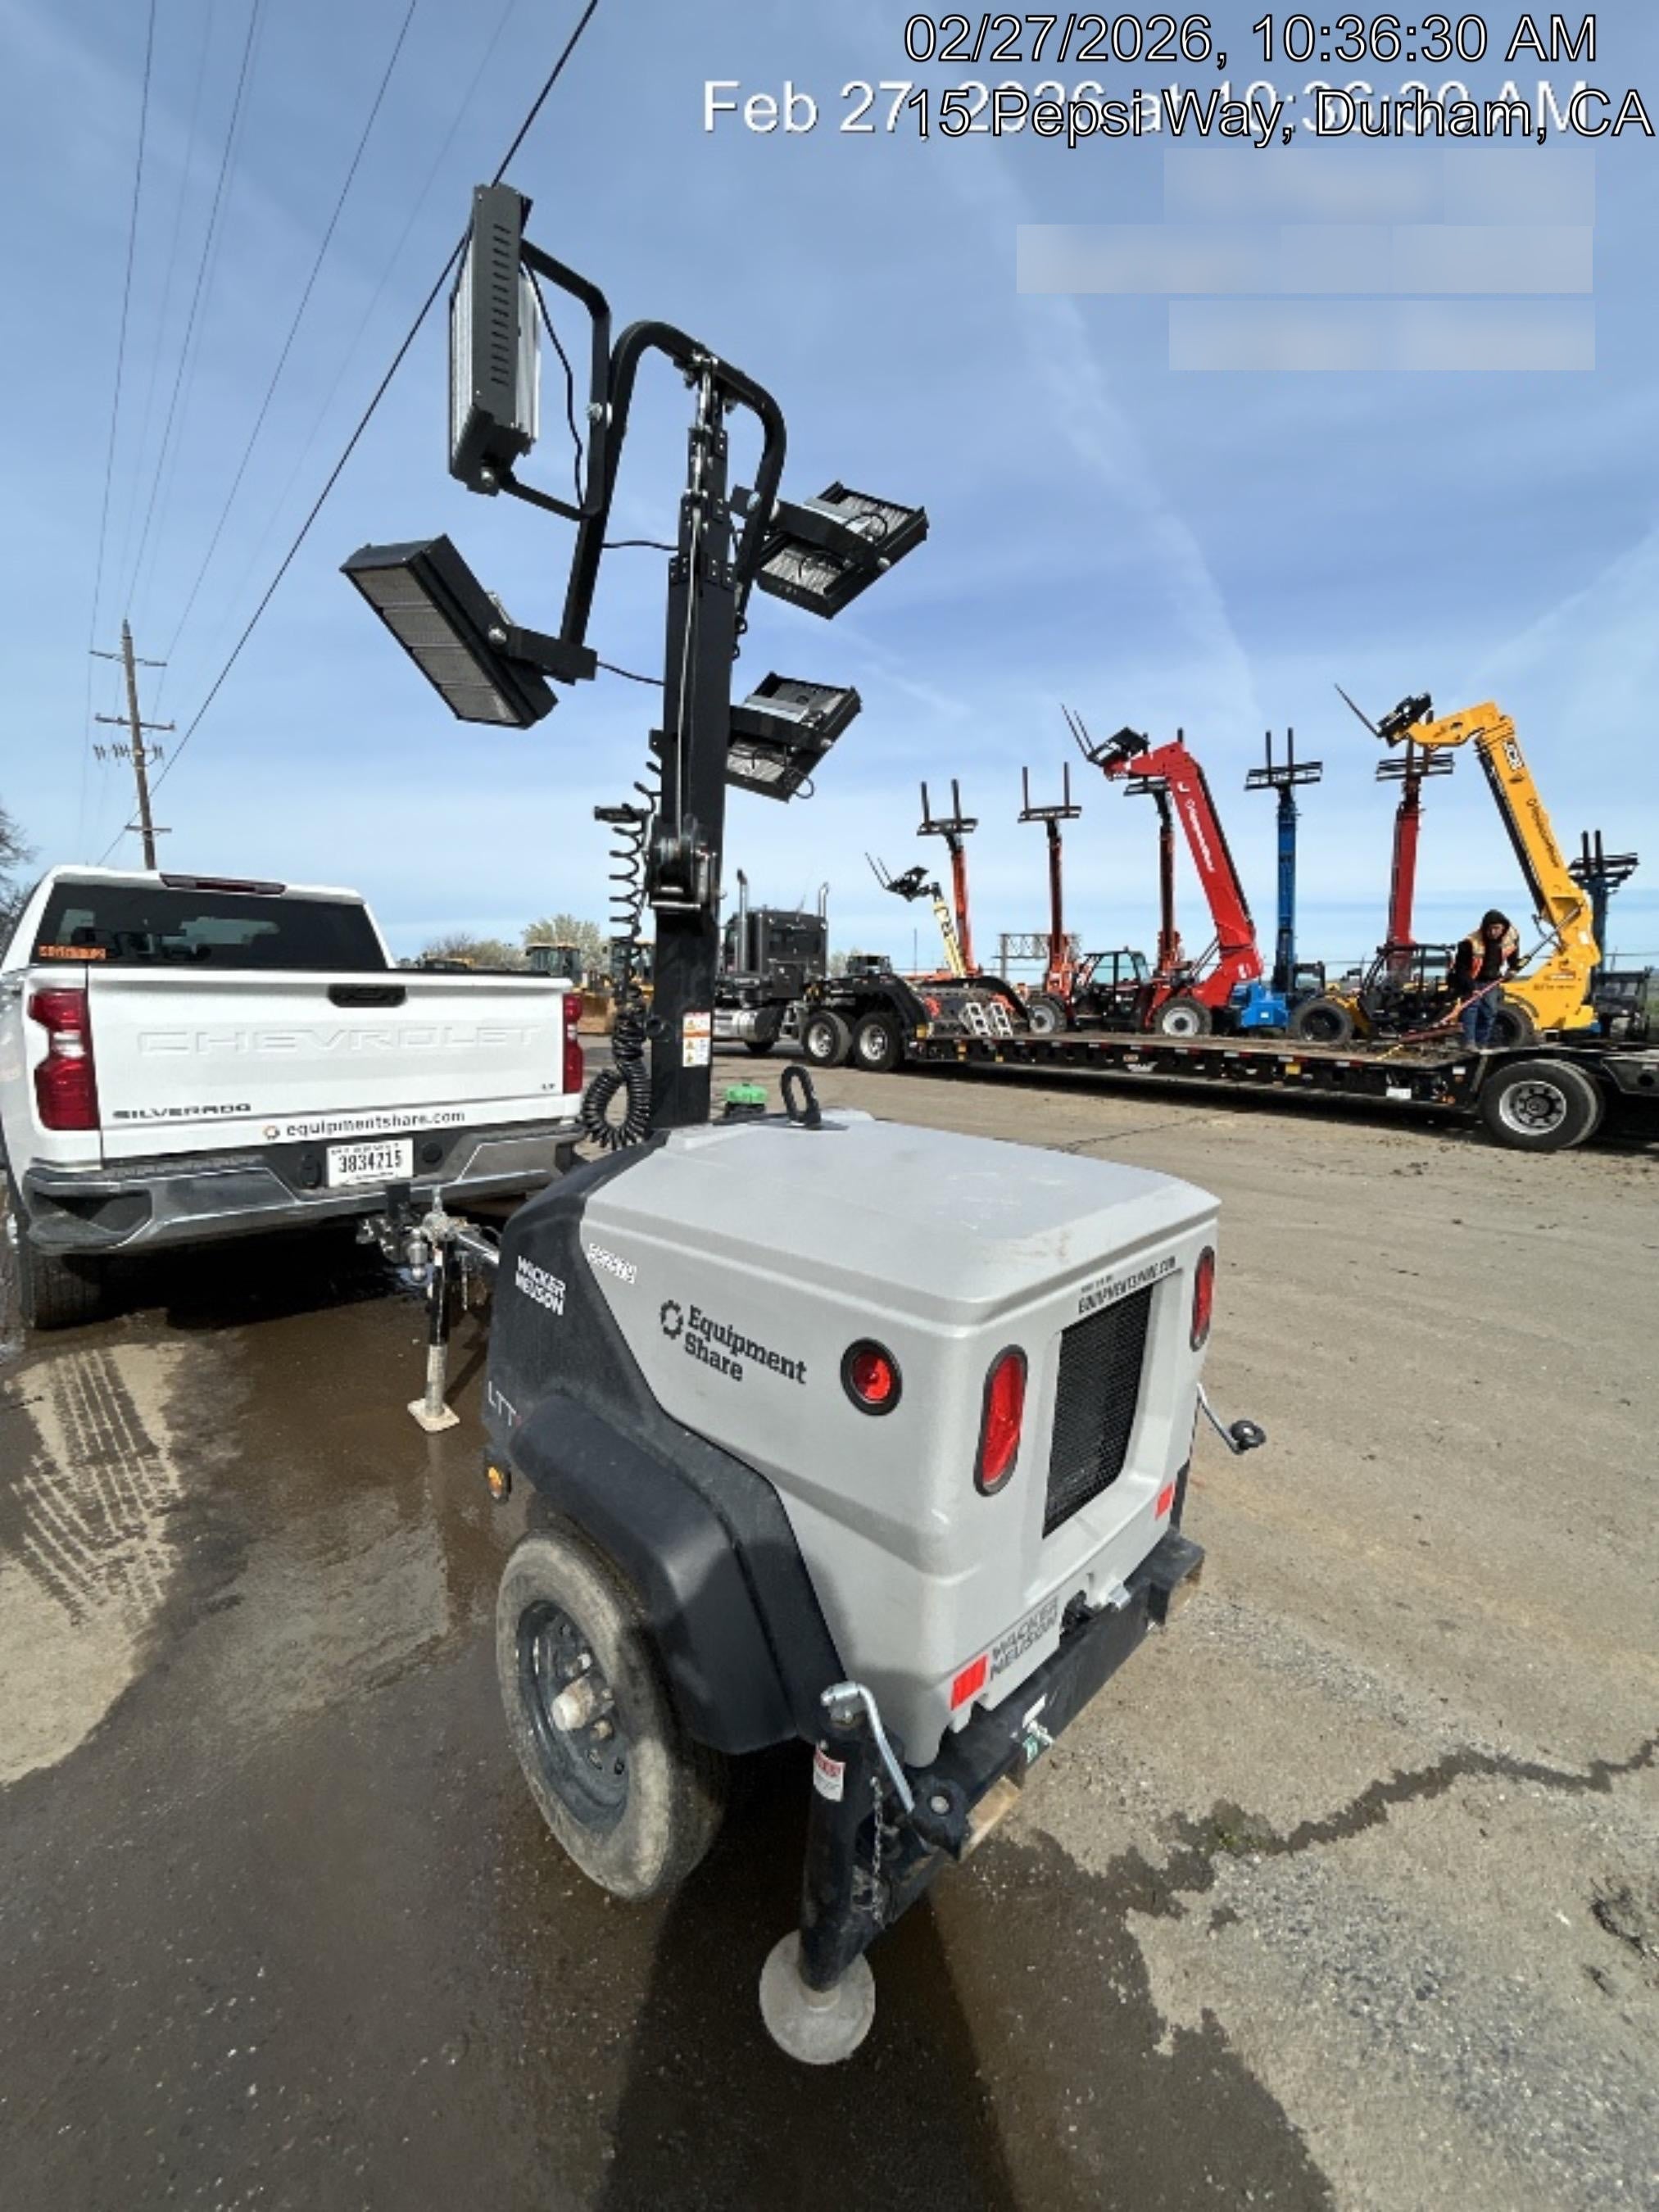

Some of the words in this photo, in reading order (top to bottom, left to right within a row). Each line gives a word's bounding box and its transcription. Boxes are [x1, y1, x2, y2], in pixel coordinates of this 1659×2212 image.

[138, 1025, 542, 1058] CHEVROLET
[113, 1103, 252, 1120] SILVERADO
[286, 1111, 465, 1137] equipmentshare.com
[684, 1331, 743, 1383] Share
[688, 1304, 808, 1385] Equipment
